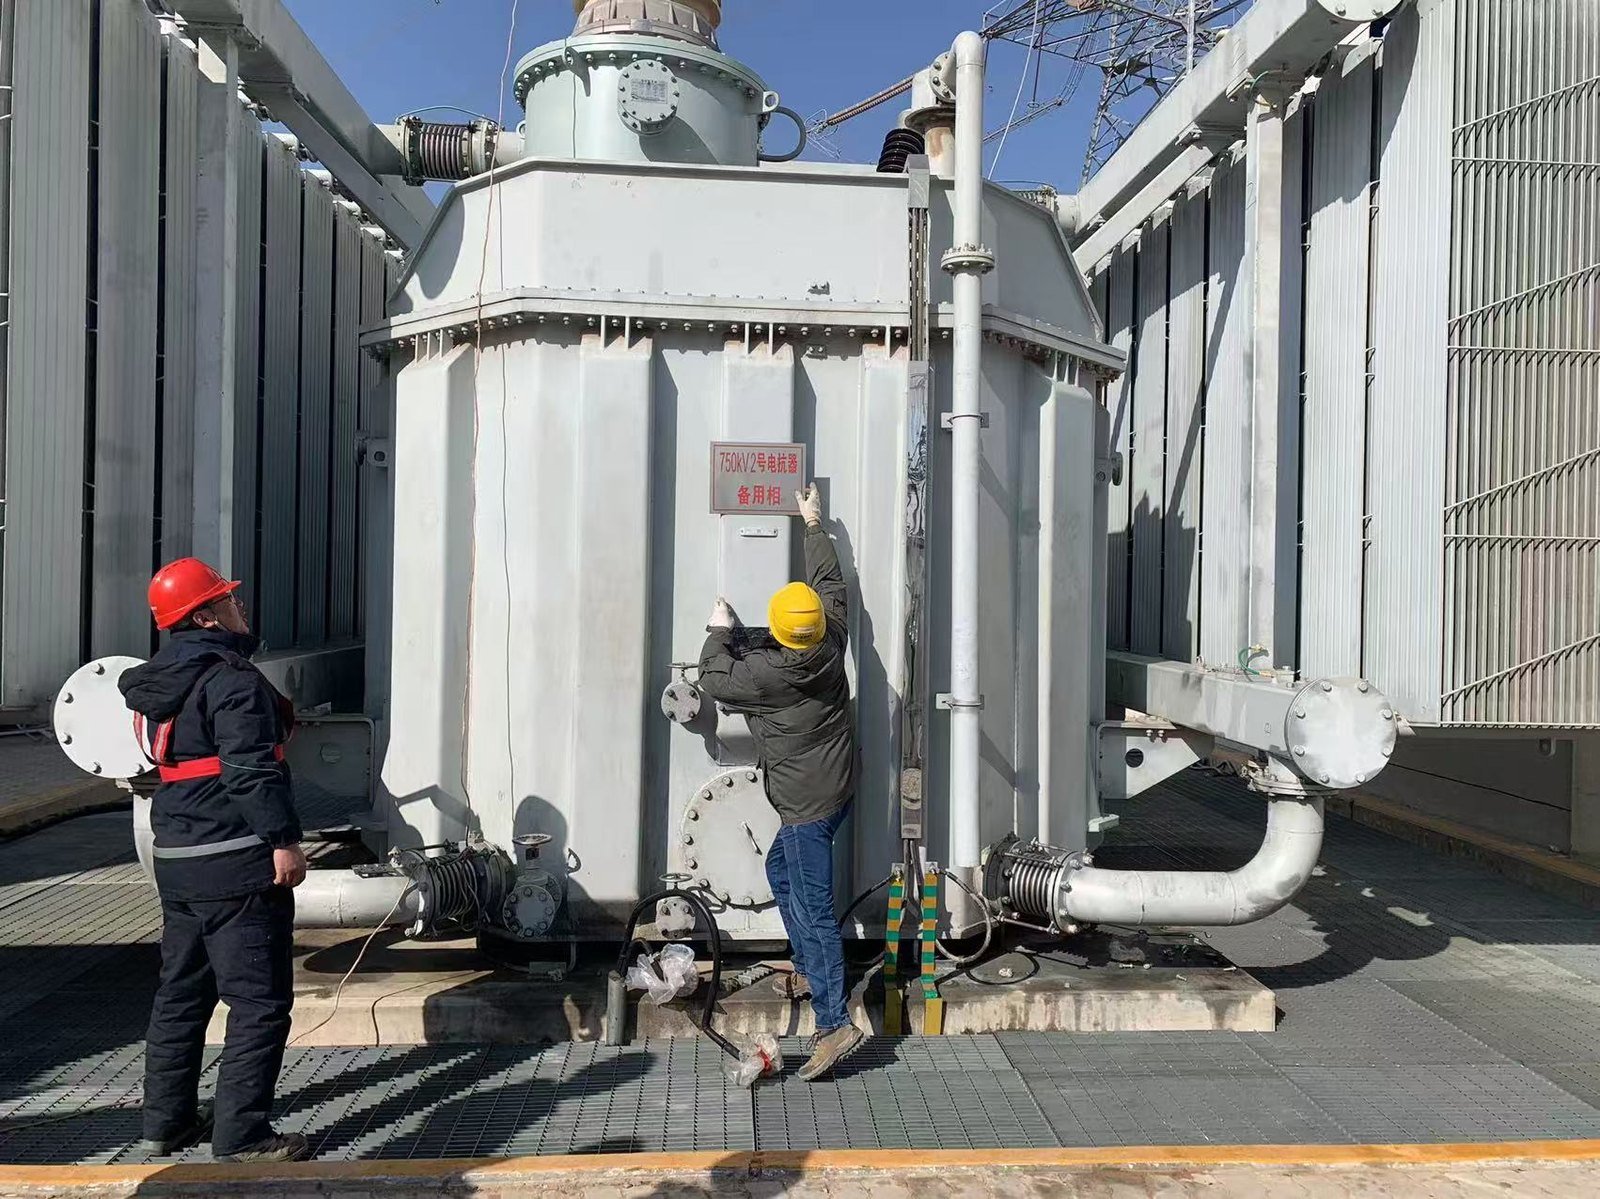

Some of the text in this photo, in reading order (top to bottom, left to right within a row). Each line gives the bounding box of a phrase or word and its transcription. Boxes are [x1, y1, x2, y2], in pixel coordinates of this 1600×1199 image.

[720, 452, 797, 473] 750kV2号电抗器
[738, 485, 781, 505] 备用相
